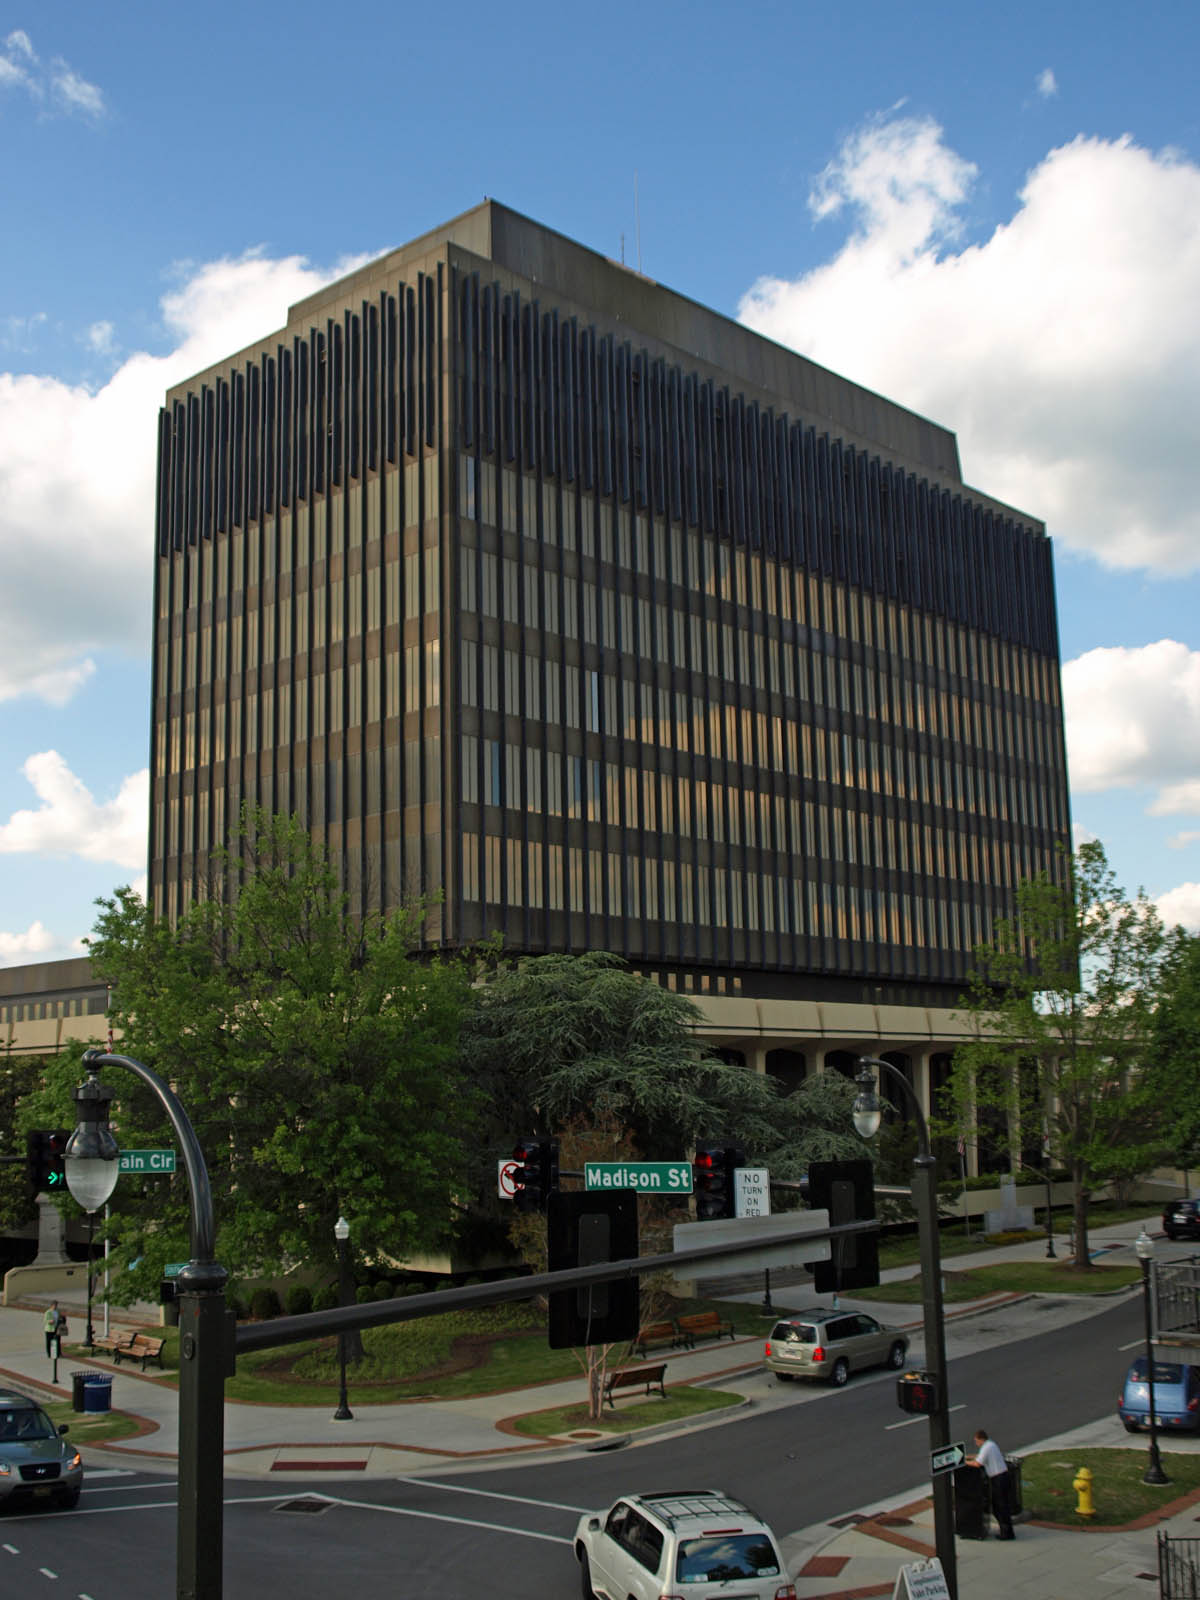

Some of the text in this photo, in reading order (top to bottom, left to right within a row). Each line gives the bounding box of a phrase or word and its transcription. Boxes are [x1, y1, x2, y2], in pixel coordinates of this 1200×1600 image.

[121, 1154, 172, 1168] ain Cir
[587, 1168, 689, 1187] Madison St
[744, 1174, 760, 1183] NO
[742, 1186, 763, 1195] TURN
[747, 1197, 759, 1206] ON
[745, 1208, 760, 1217] RED
